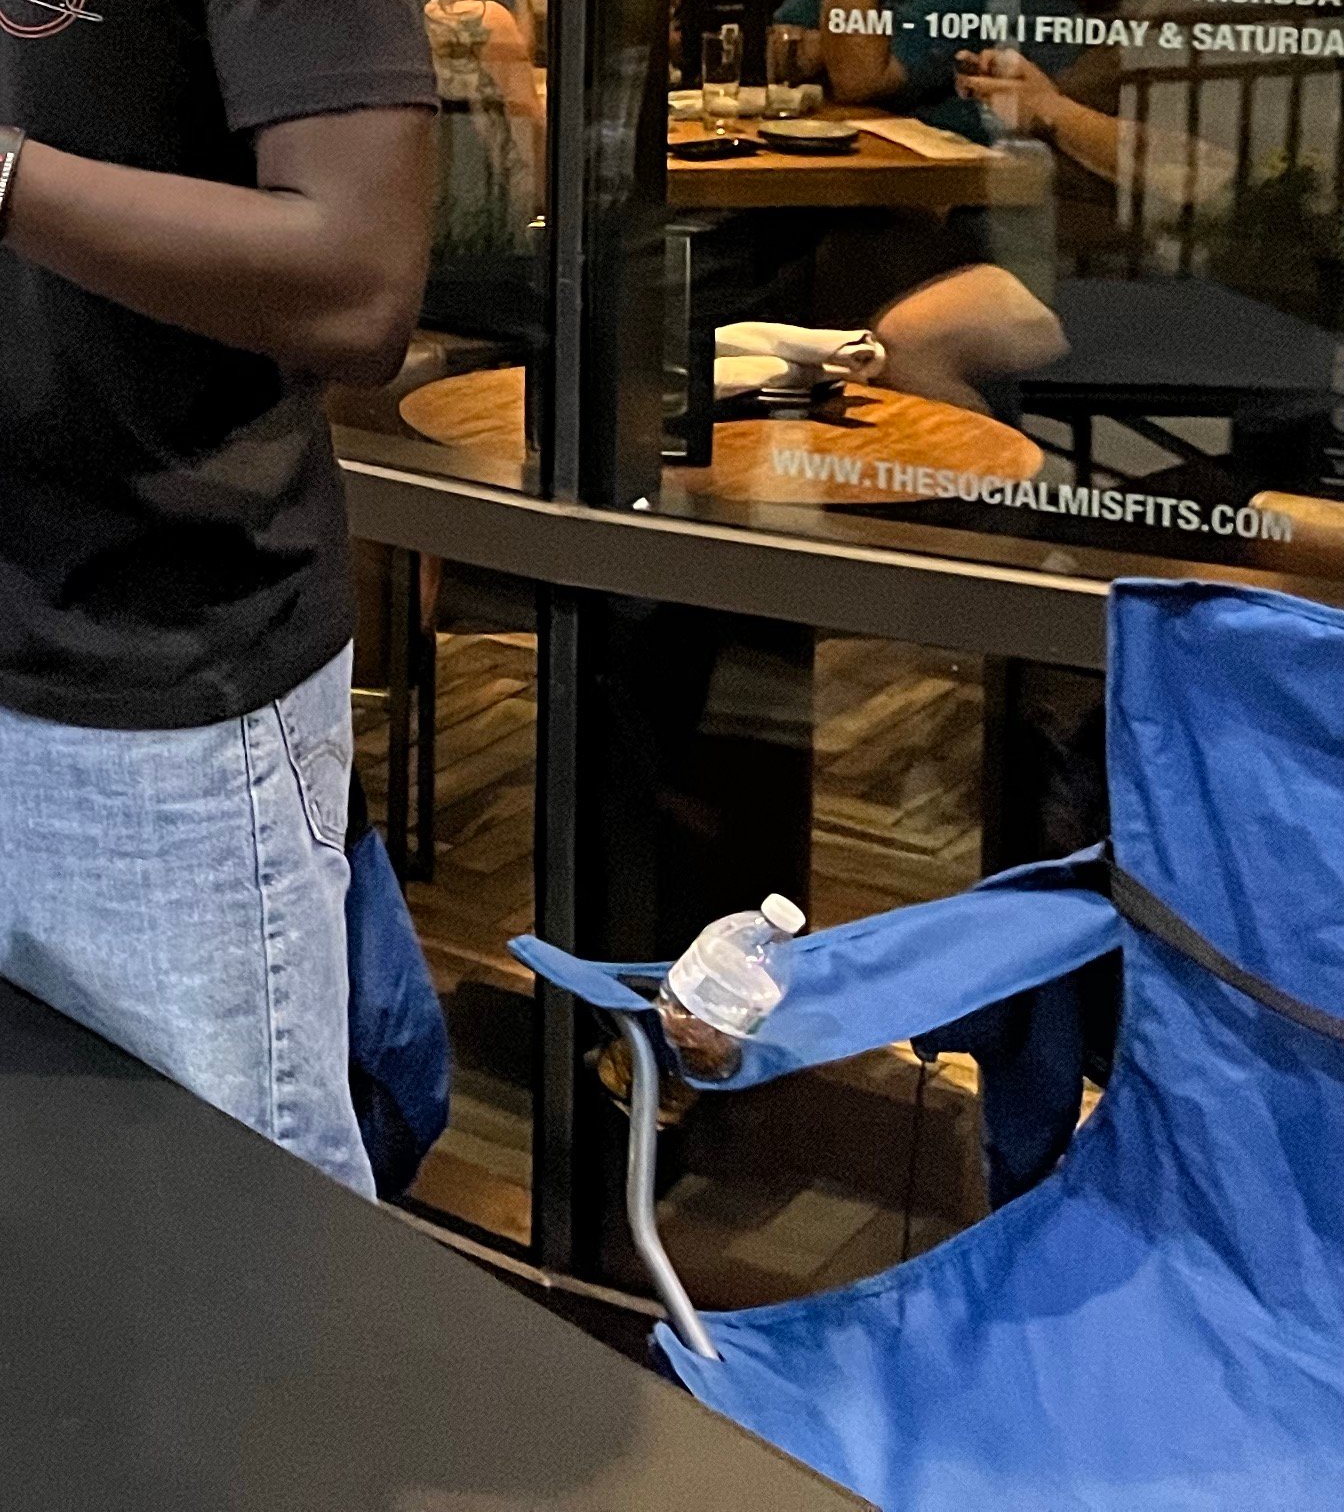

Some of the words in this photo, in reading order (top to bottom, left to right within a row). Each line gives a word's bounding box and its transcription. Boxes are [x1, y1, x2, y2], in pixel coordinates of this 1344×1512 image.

[828, 8, 893, 35] 8AM
[925, 13, 1008, 41] 10PM
[1034, 17, 1149, 46] FRIDAY
[1159, 22, 1183, 50] &
[772, 446, 1295, 544] WWW.THESOCIALMISFITS.COM
